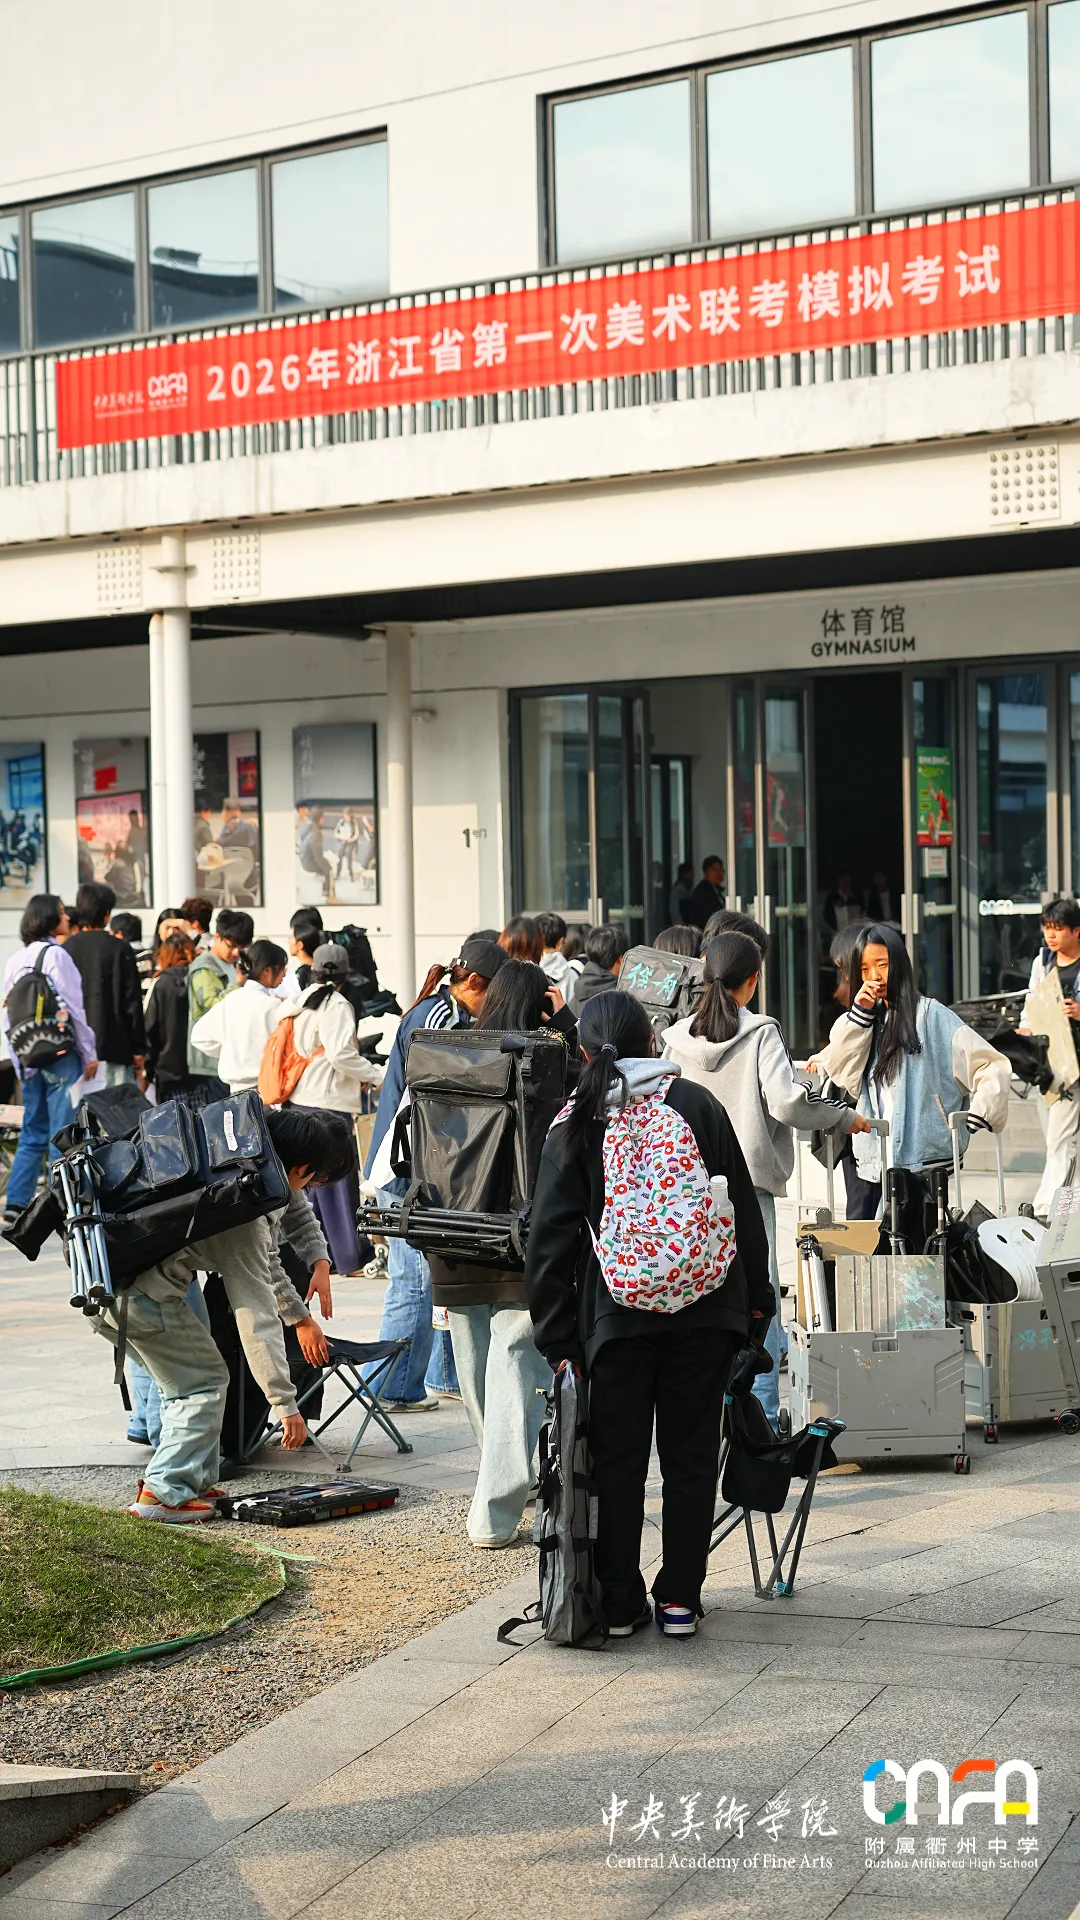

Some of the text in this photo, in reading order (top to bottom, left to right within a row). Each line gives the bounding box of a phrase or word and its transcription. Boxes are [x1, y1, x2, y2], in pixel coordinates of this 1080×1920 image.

[206, 243, 1002, 402] 2026年浙江省第一次美术联考模拟考试
[820, 604, 906, 639] 体育馆
[811, 636, 916, 658] GYMNASIUM
